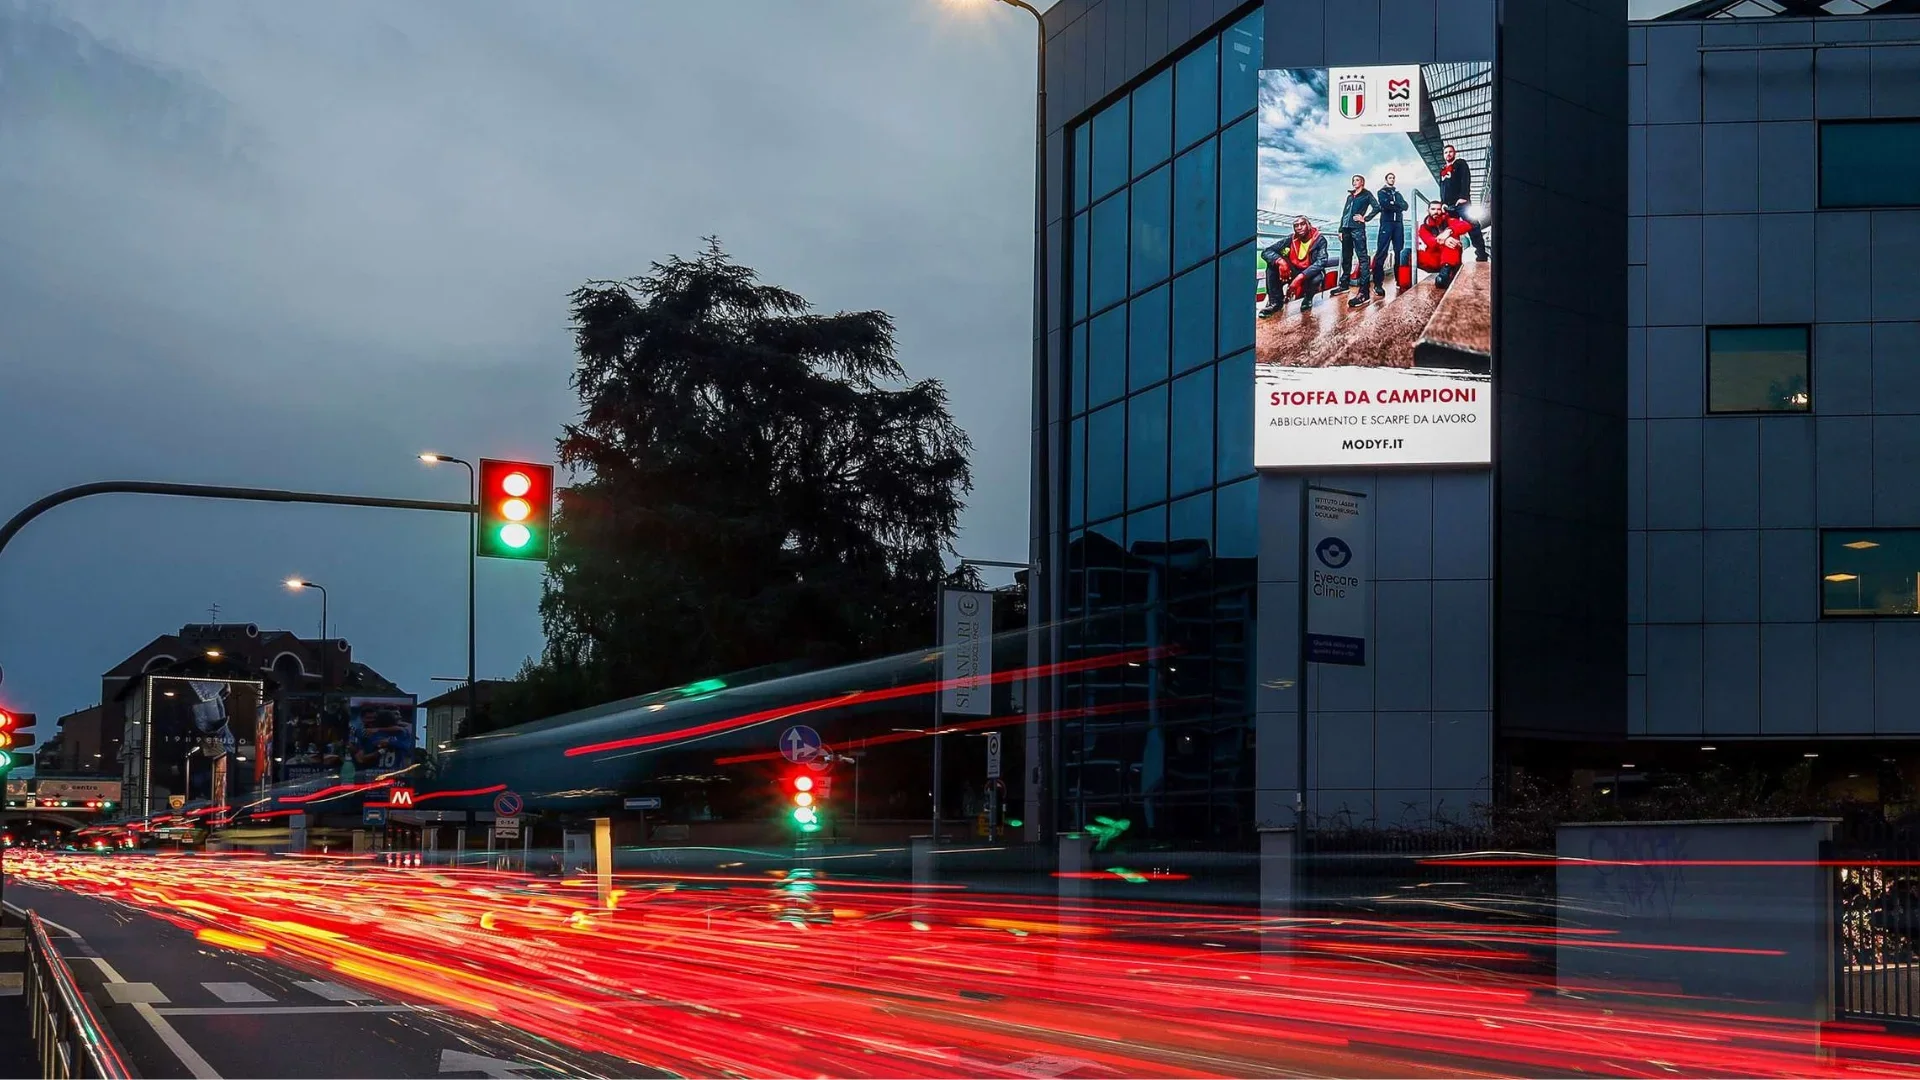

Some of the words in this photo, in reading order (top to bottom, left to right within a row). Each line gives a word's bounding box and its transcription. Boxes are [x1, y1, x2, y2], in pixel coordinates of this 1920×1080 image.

[1341, 84, 1363, 92] ITALIA
[1270, 391, 1338, 406] STOFFA
[1344, 390, 1370, 405] DA
[1376, 388, 1476, 404] CAMPIONI
[1270, 415, 1358, 426] ABBIGLIAMENTO
[1361, 415, 1366, 425] E
[1370, 414, 1409, 425] SCARPE
[1413, 414, 1428, 424] DA
[1432, 413, 1476, 424] LAVORO
[1342, 439, 1404, 450] MODYF.IT
[1314, 570, 1359, 587] Eyecare
[1313, 583, 1346, 599] Clinic
[391, 791, 412, 805] M
